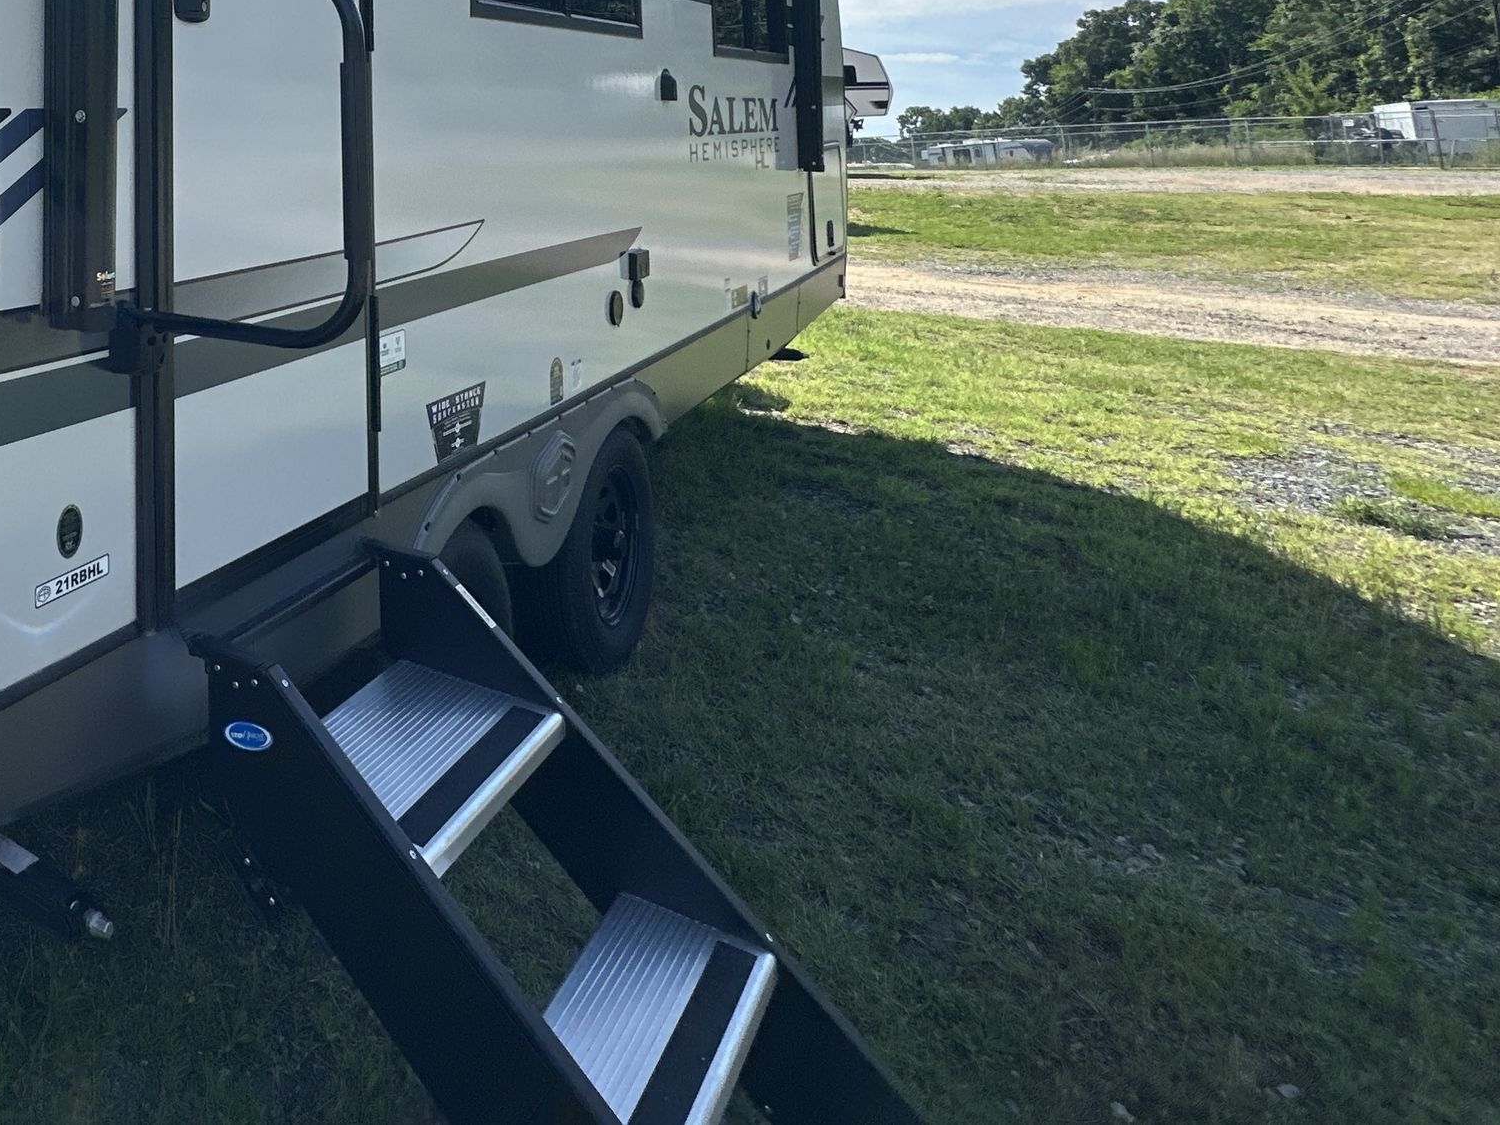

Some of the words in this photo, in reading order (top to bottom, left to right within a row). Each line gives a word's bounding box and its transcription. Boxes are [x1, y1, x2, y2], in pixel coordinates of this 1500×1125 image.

[688, 84, 779, 137] SALEM
[689, 136, 780, 163] HEMISPHERE
[431, 399, 450, 414] WIDE
[55, 561, 104, 595] 21RBHL
